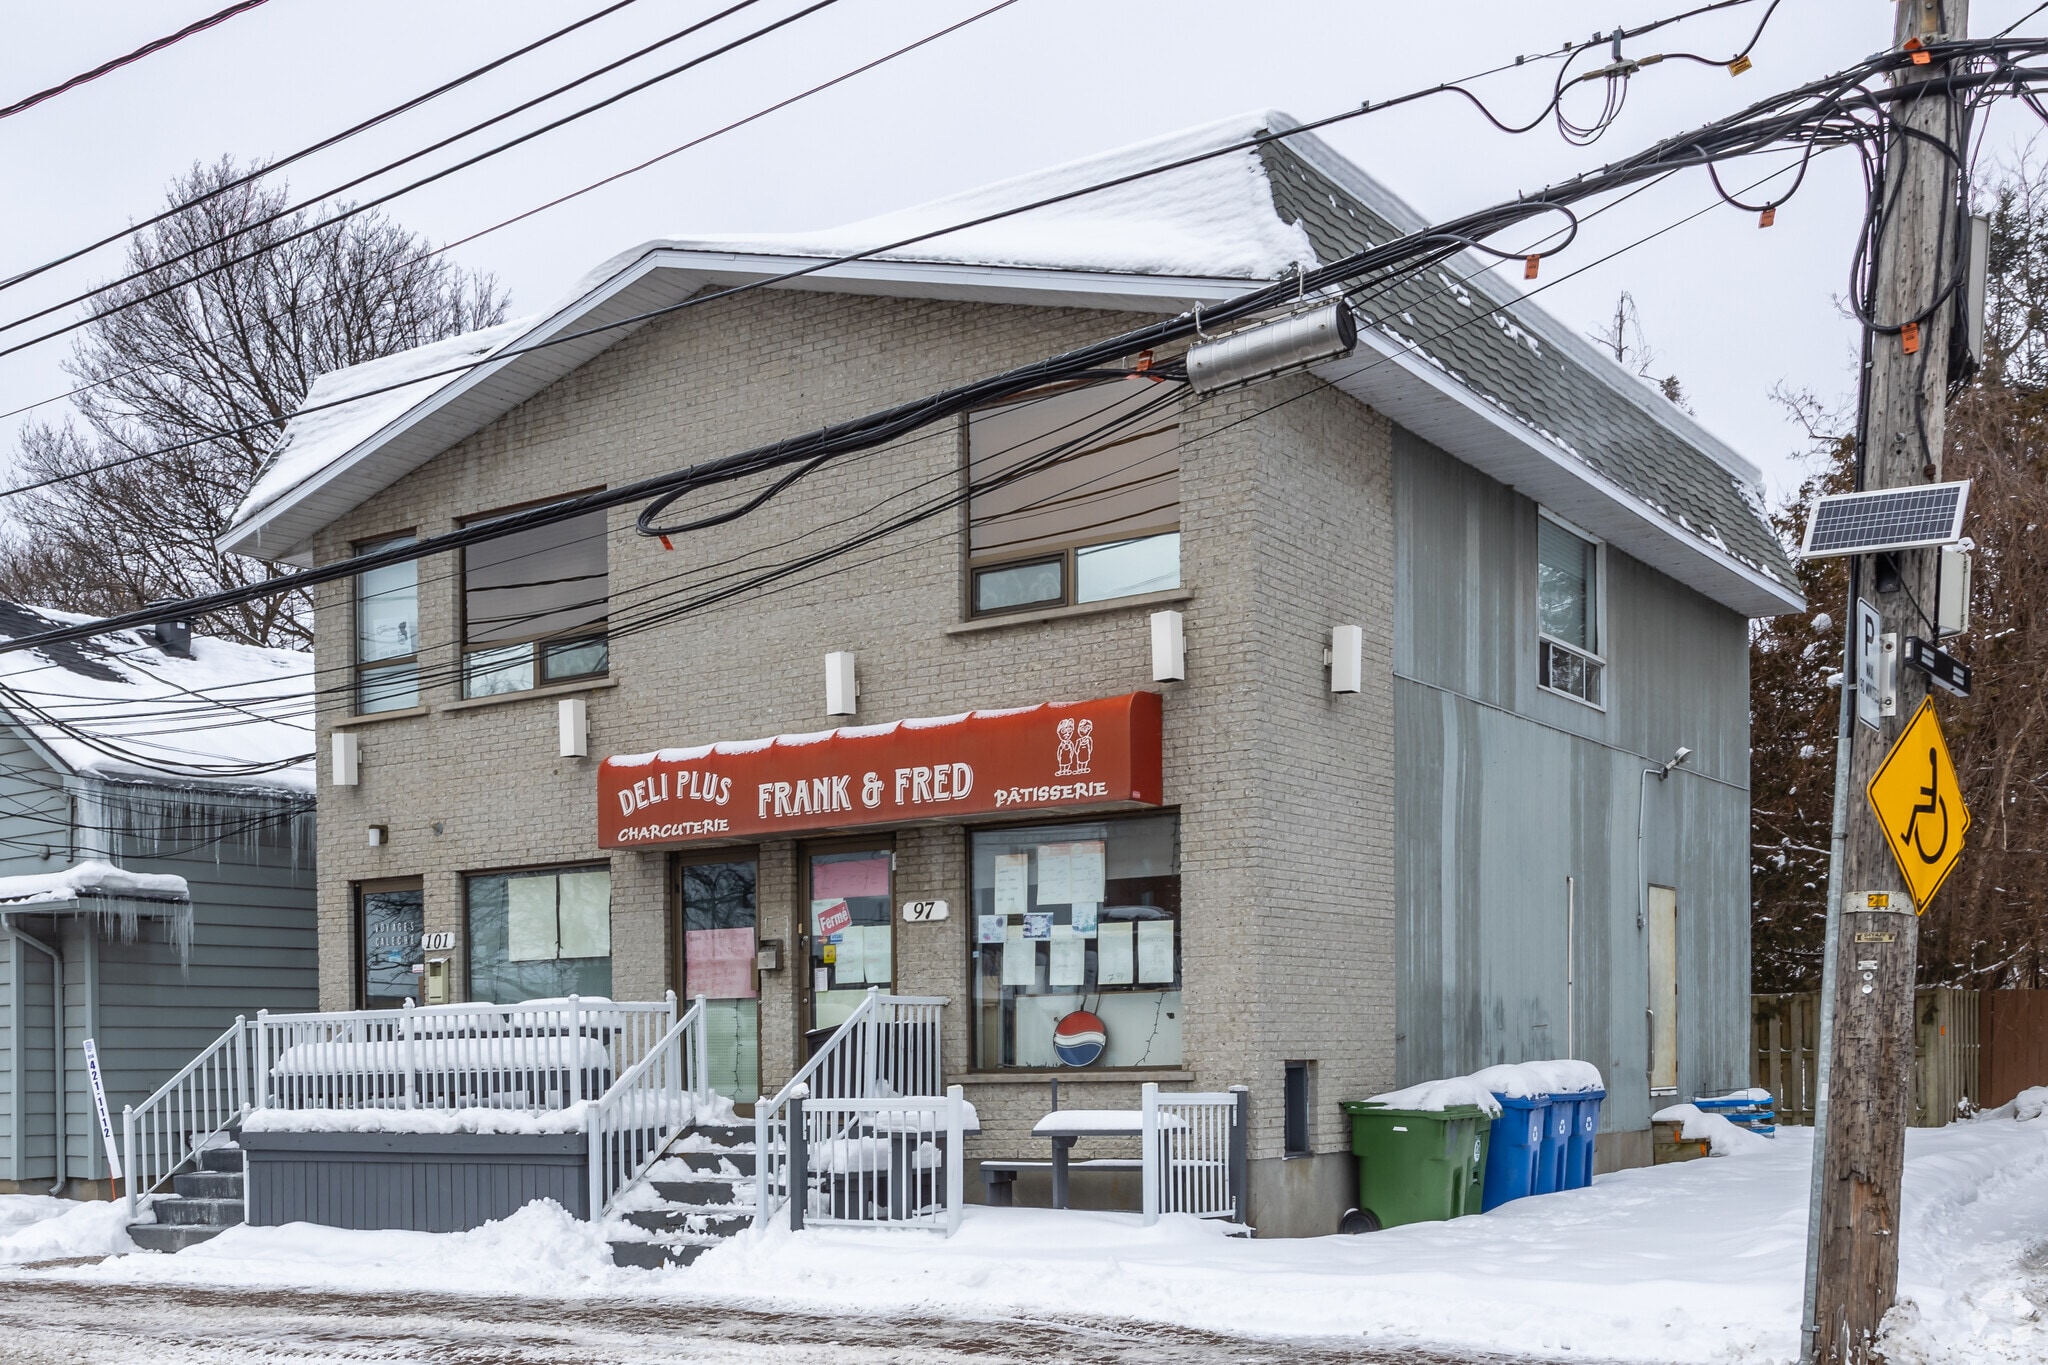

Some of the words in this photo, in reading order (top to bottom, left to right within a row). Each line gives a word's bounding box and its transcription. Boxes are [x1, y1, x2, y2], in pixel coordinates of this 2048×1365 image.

[1865, 613, 1875, 657] P
[618, 773, 669, 817] DELI
[676, 770, 733, 806] PLUS
[758, 774, 852, 819] FRANK
[861, 771, 885, 809] &
[894, 762, 974, 806] FRED
[993, 781, 1109, 808] PÂTISSERIE
[617, 818, 730, 842] CHARCUTERIE
[914, 901, 935, 920] 97
[1868, 894, 1888, 907] 21
[374, 921, 415, 933] VOYAGES
[820, 906, 849, 931] Fermé
[425, 933, 449, 949] 101
